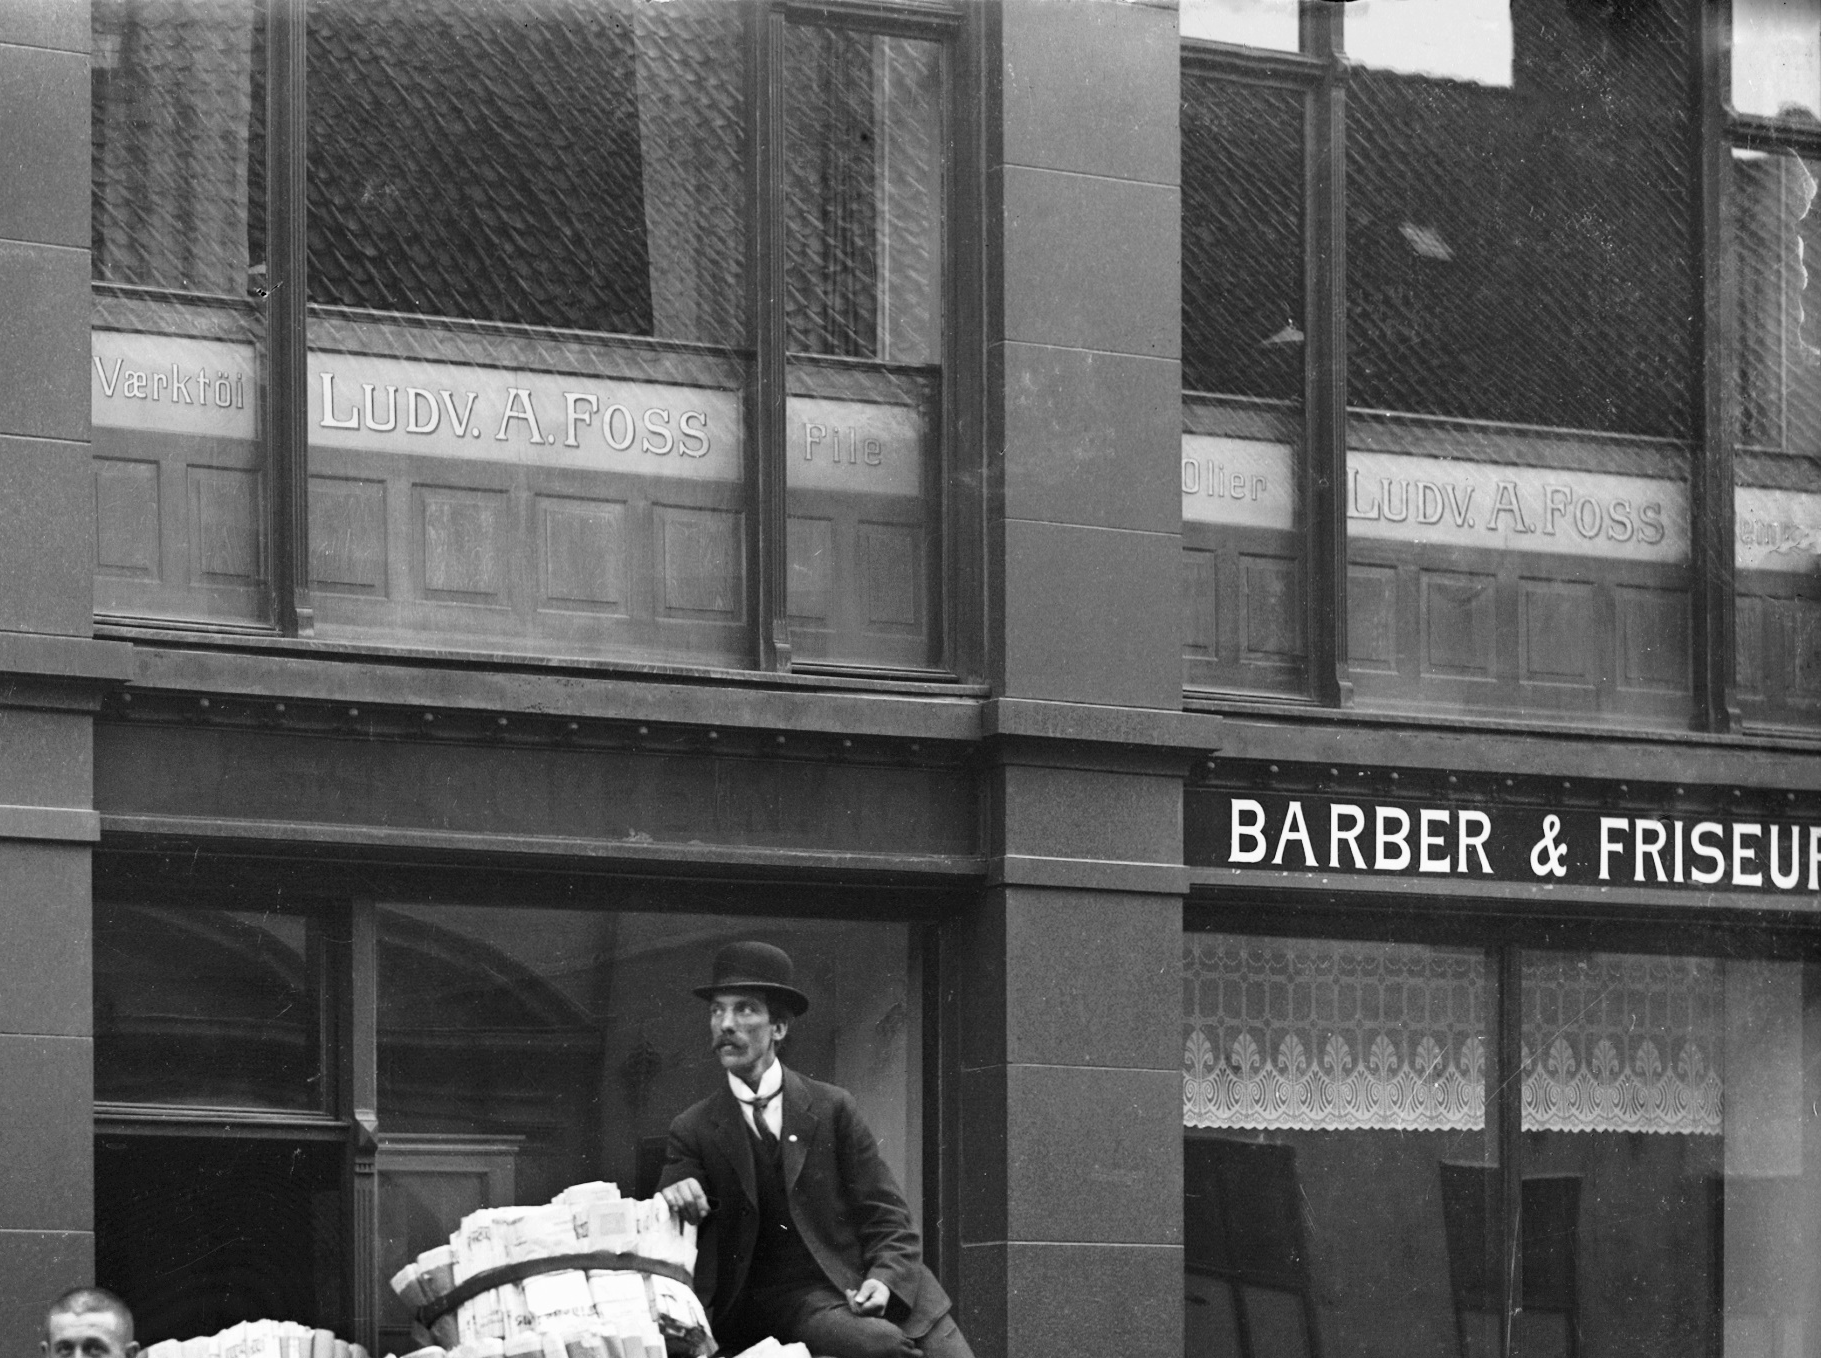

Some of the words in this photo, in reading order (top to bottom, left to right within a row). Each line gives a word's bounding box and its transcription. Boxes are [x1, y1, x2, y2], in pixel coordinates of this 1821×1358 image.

[93, 356, 244, 410] Værktöi
[320, 372, 481, 438] LUDV.
[803, 423, 883, 467] File
[1182, 457, 1267, 501] Olier
[1347, 467, 1475, 528] LUDV.
[1228, 798, 1494, 874] BARBER
[1530, 814, 1568, 878] &
